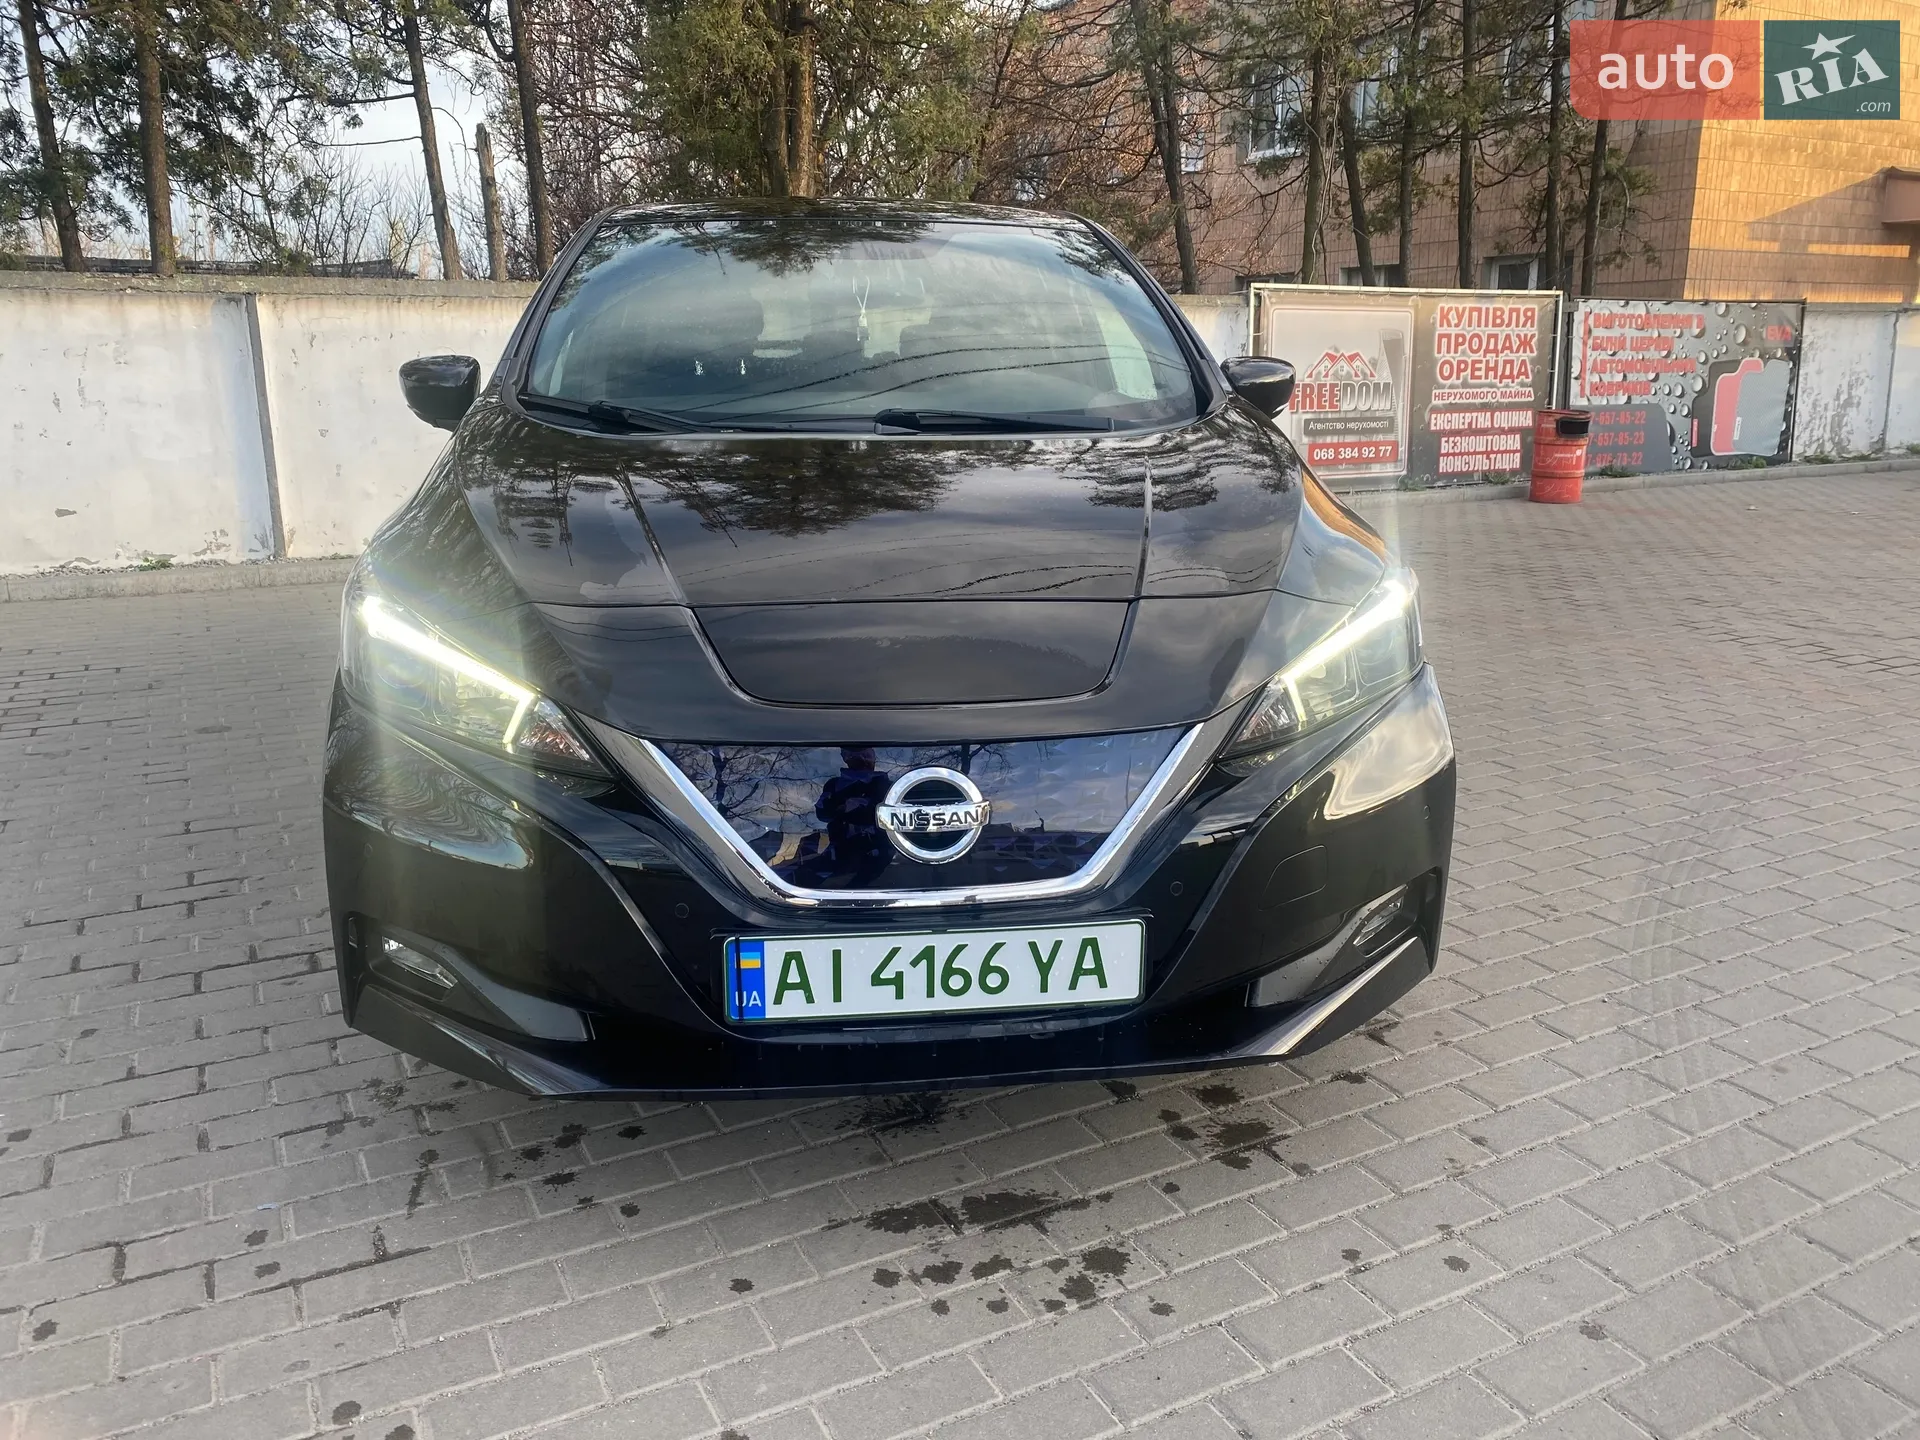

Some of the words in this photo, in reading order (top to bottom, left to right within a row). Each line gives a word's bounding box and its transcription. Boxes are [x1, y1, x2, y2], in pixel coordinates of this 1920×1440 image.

[1438, 305, 1536, 329] КУПІВЛЯ
[1436, 332, 1537, 358] ПРОДАЖ
[1438, 358, 1531, 384] ОРЕНДА
[1289, 381, 1393, 412] FREEDOM
[1434, 390, 1498, 401] НЕРУХОМОГО
[1500, 388, 1533, 400] МАЙНА
[1309, 421, 1345, 431] Агентство
[1346, 420, 1389, 431] нерухомості
[1430, 411, 1491, 430] ЕКСПЕРТНА
[1493, 410, 1533, 429] ОЦІНКА
[1313, 448, 1335, 460] 068
[1338, 447, 1359, 459] 384
[1361, 446, 1376, 458] 92
[1379, 445, 1393, 457] 77
[1441, 434, 1520, 453] БЕЗКОШТОВНА
[1439, 453, 1520, 473] КОНСУЛЬТАЦІЯ
[890, 810, 980, 827] NISSAN
[772, 948, 842, 1005] AI
[870, 942, 1010, 1000] 4166
[1028, 936, 1108, 993] YA
[735, 990, 762, 1008] UA
